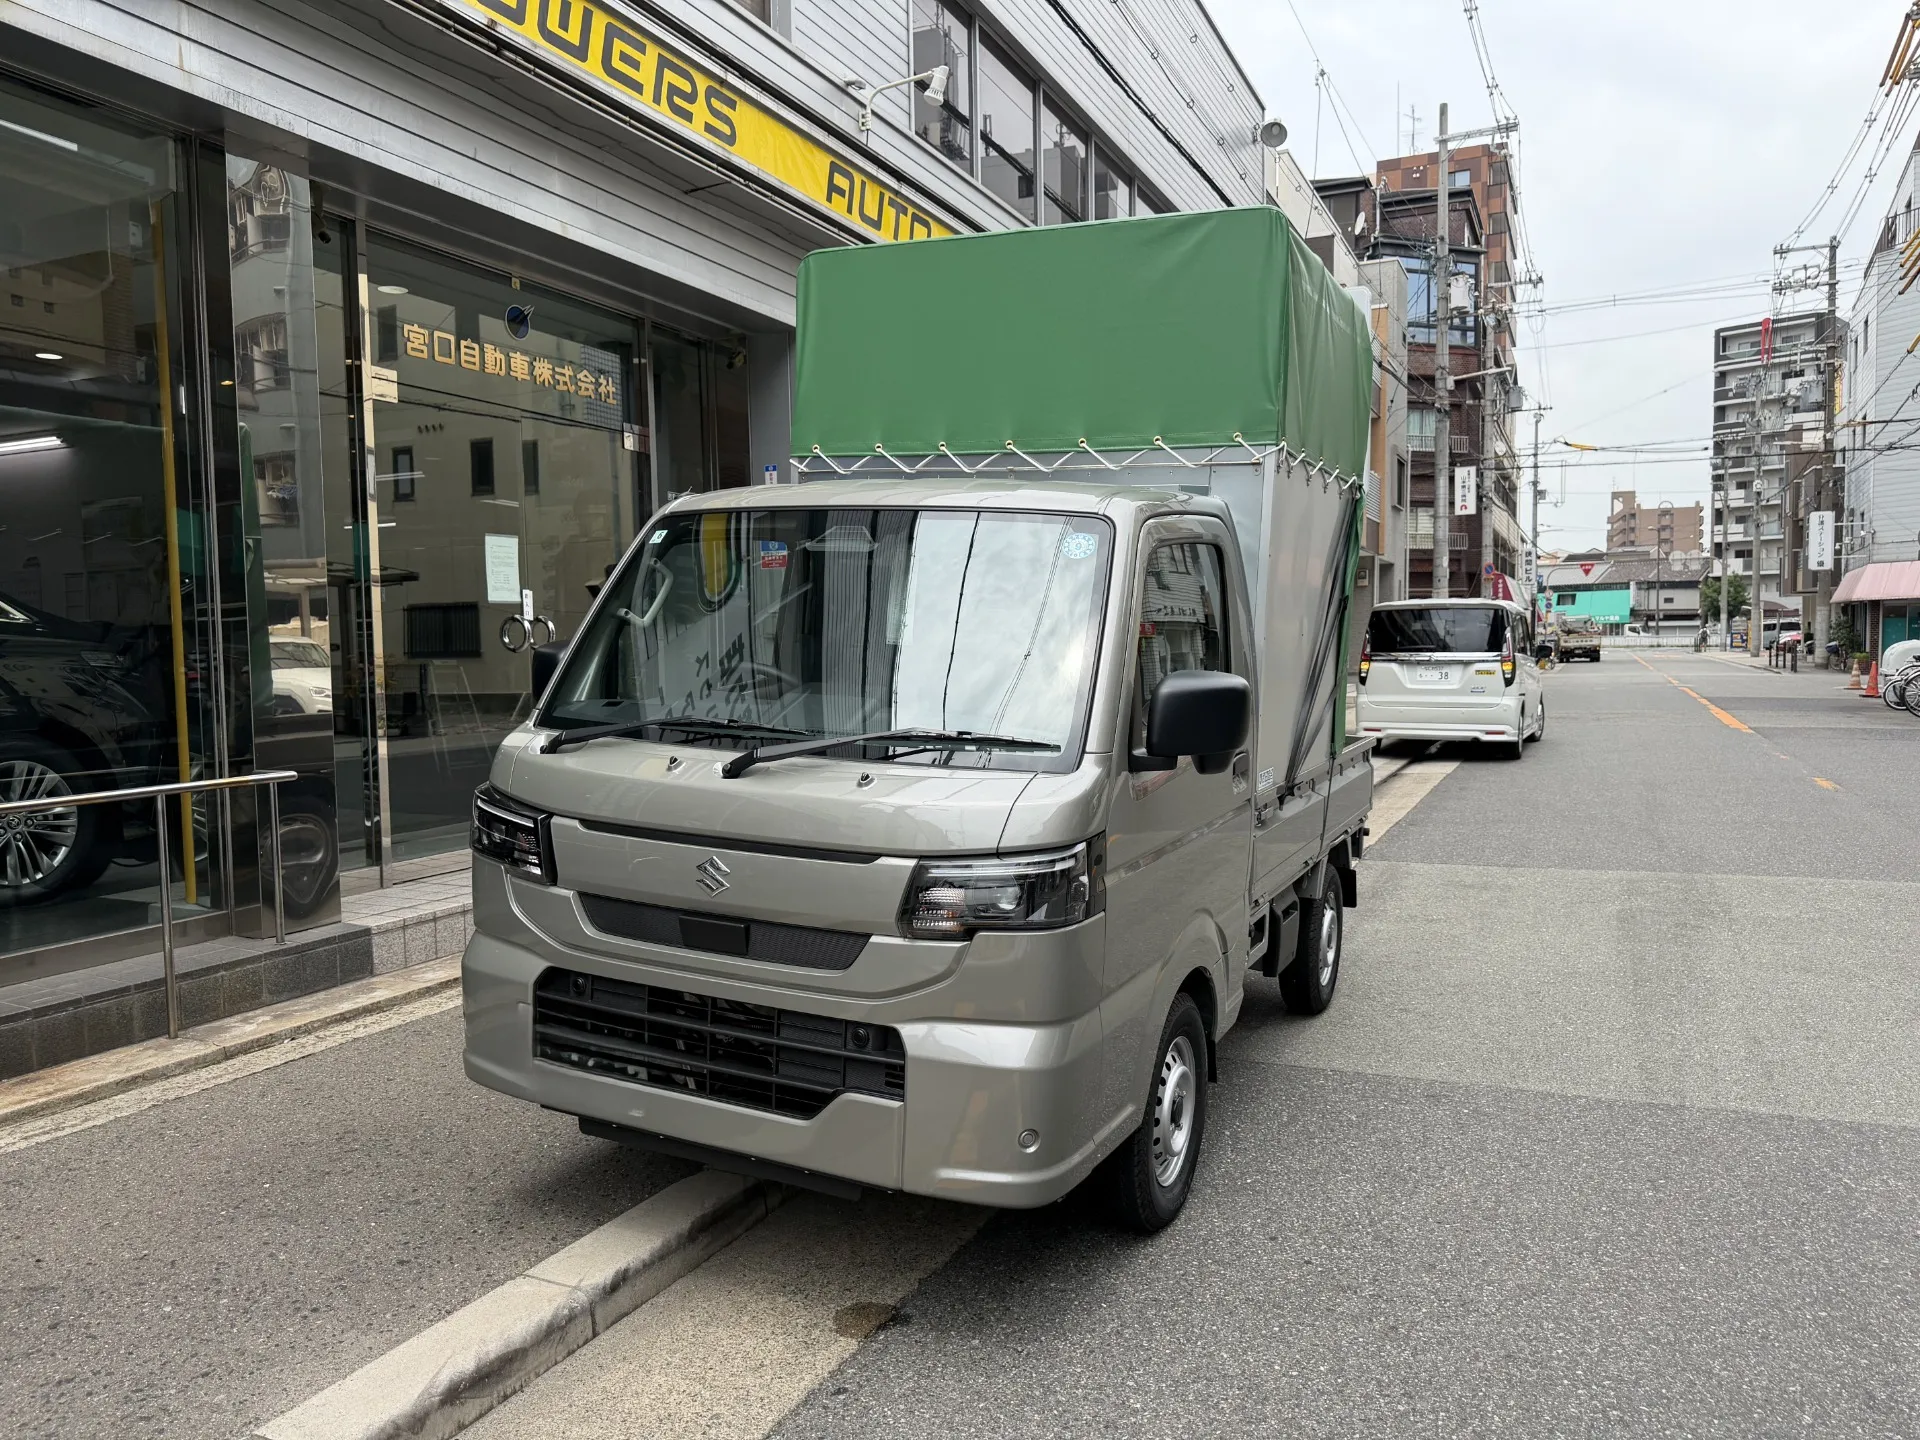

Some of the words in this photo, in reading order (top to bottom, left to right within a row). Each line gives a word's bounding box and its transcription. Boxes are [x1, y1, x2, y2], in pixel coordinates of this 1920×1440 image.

[403, 323, 617, 406] 宮口自動車株式会社
[1438, 671, 1449, 680] 38
